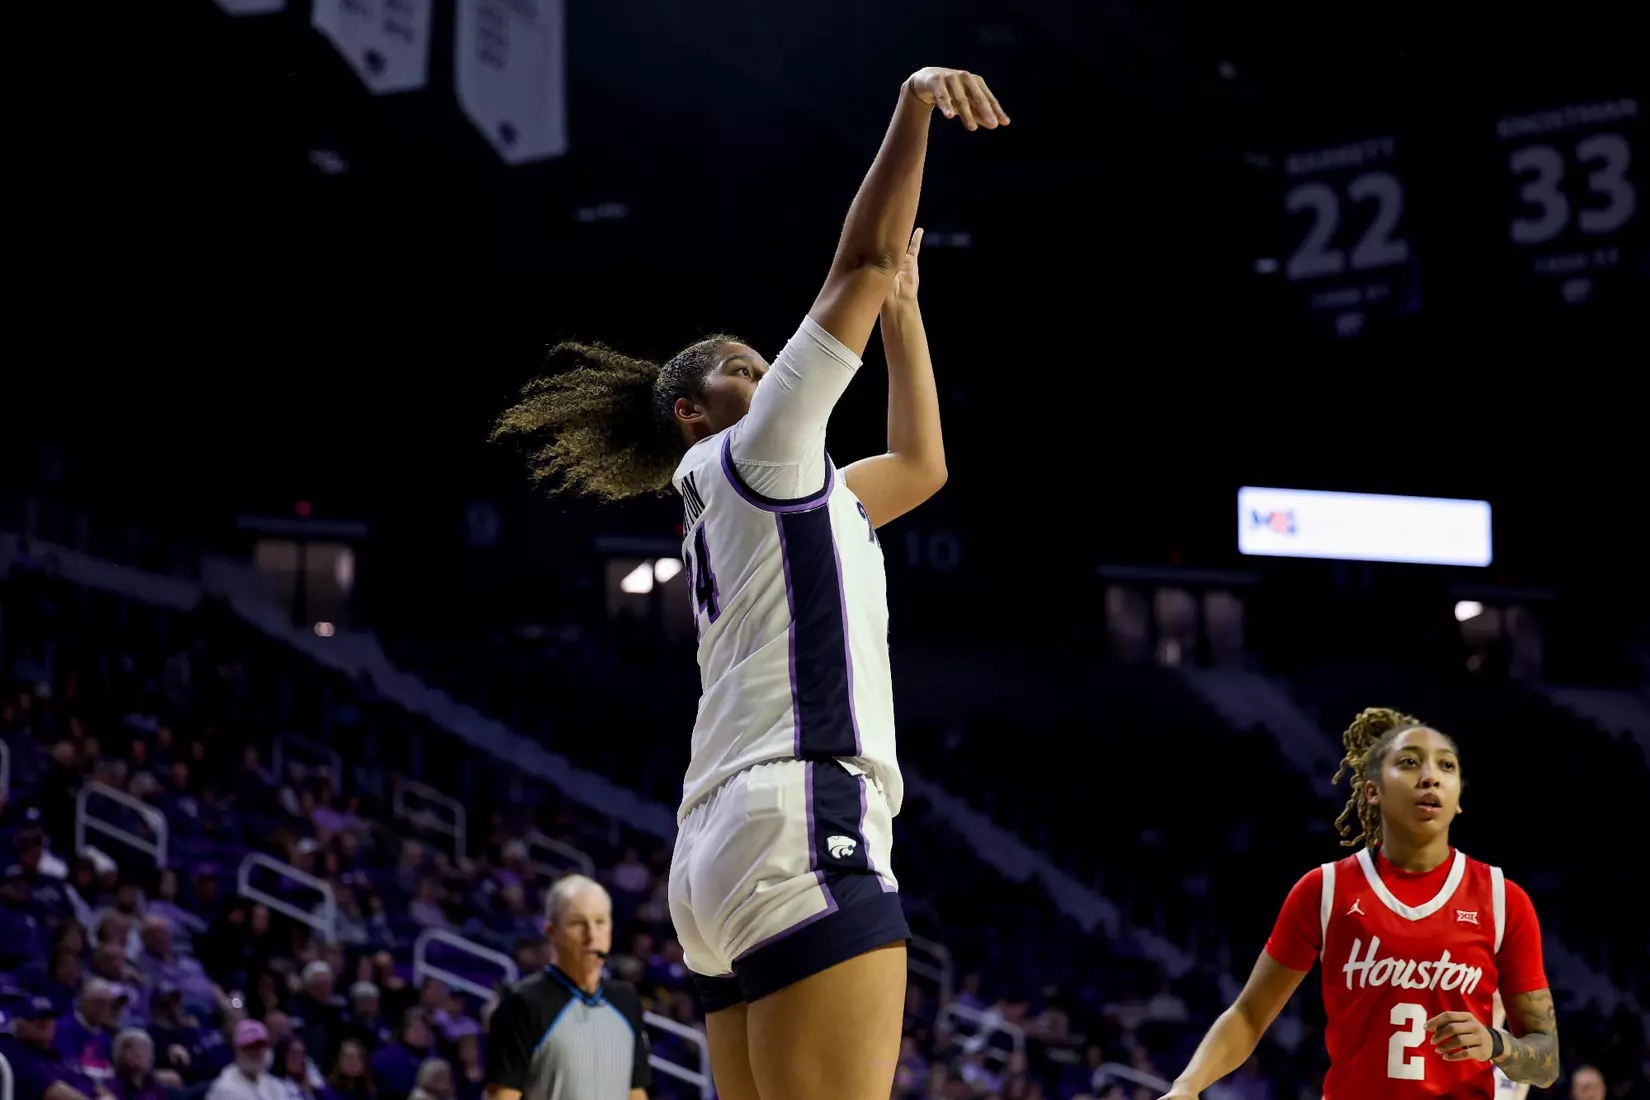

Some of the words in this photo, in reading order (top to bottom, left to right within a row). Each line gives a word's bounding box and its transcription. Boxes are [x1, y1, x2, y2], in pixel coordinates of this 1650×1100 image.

[1284, 170, 1411, 281] 22
[1508, 131, 1638, 246] 33
[903, 529, 960, 573] 10
[1342, 935, 1483, 995] Houston
[1387, 1002, 1428, 1080] 2
